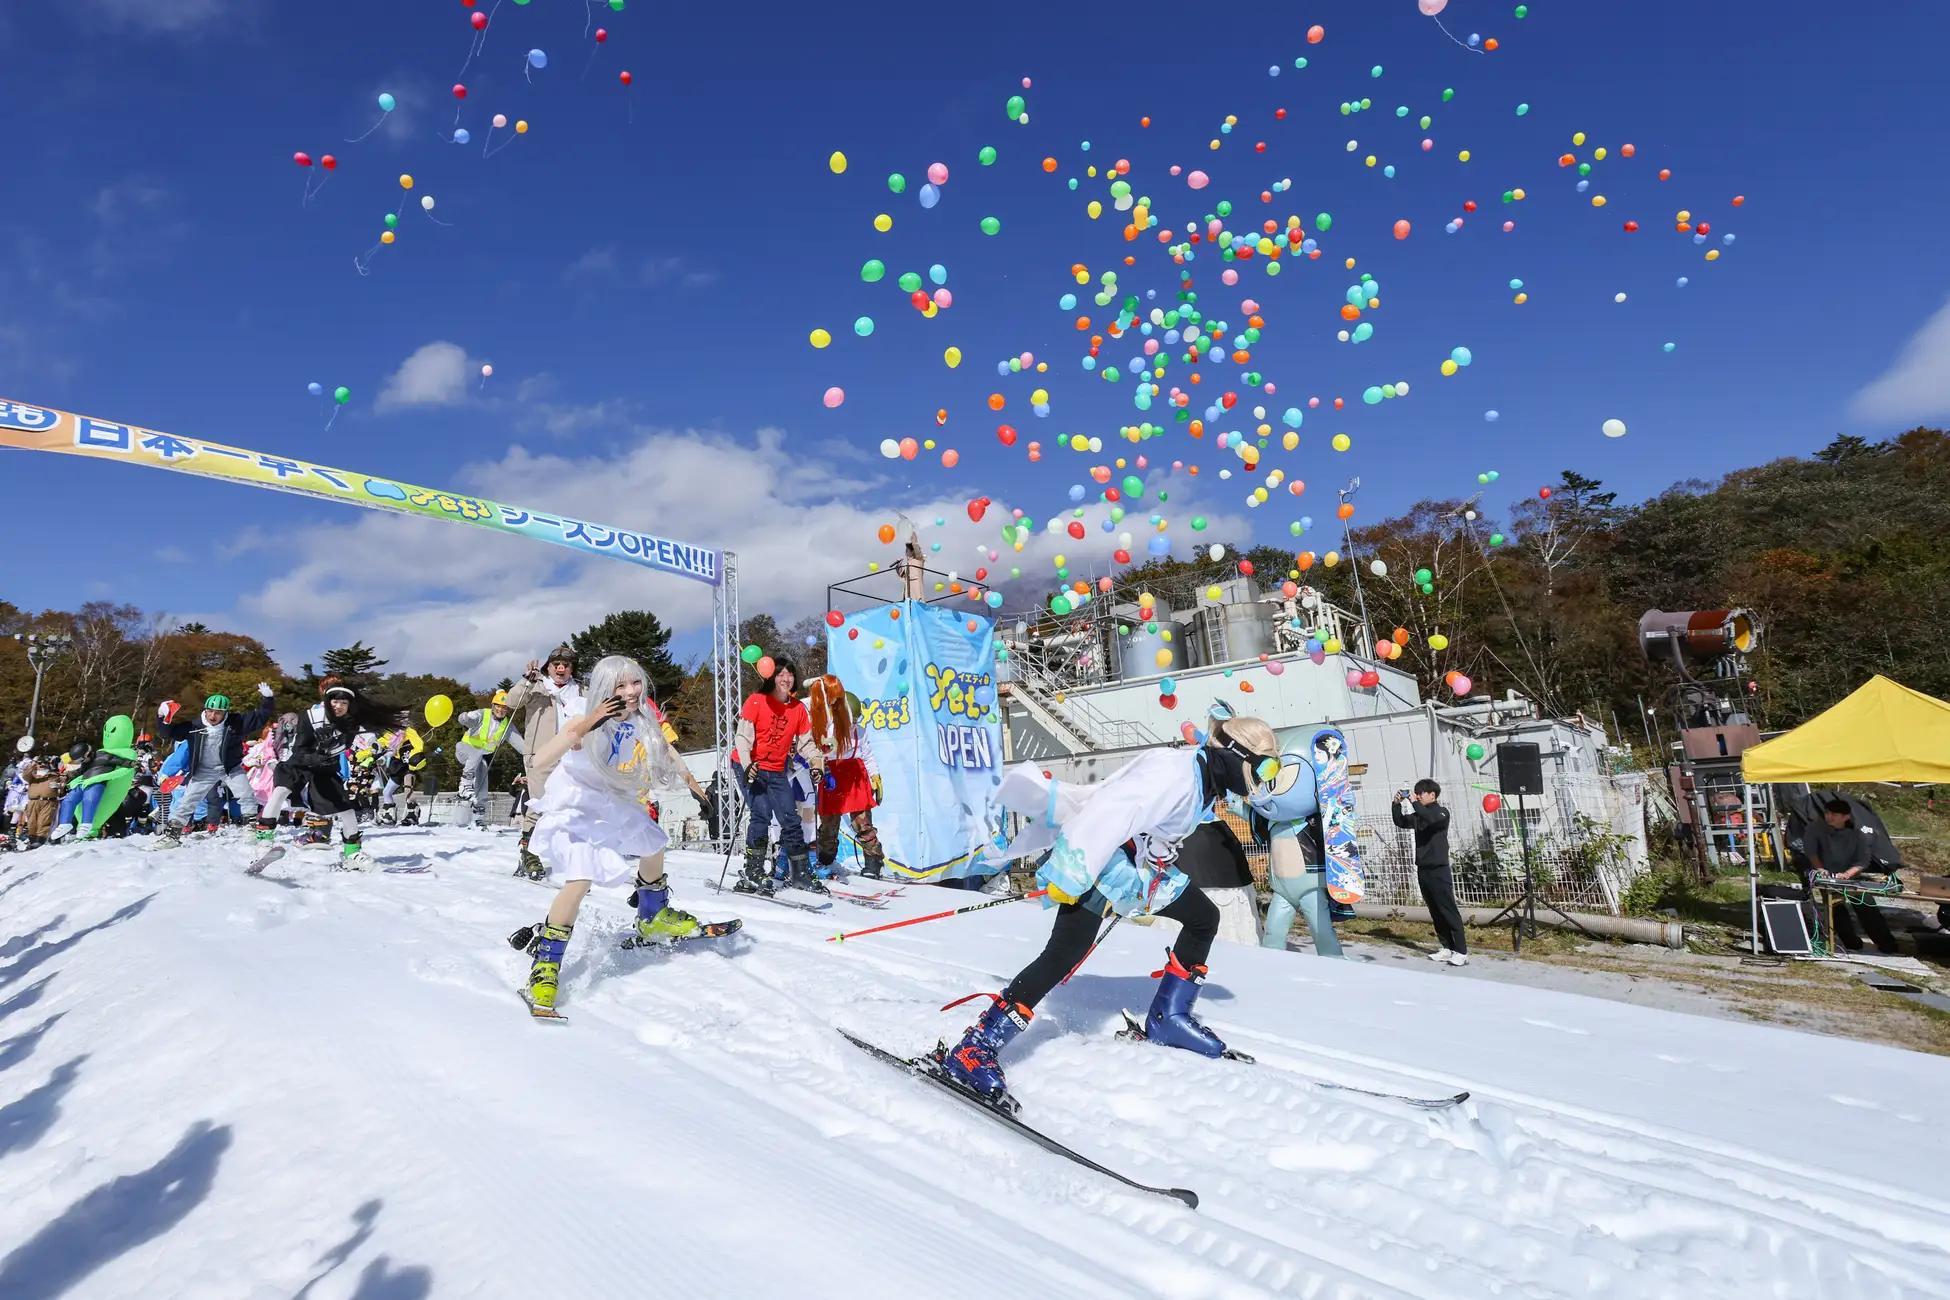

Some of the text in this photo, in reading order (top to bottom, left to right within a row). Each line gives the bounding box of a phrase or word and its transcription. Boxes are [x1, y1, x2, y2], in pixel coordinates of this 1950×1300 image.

[77, 417, 352, 491] 日本一早く
[858, 696, 910, 730] Yeti
[938, 723, 992, 768] OPEN
